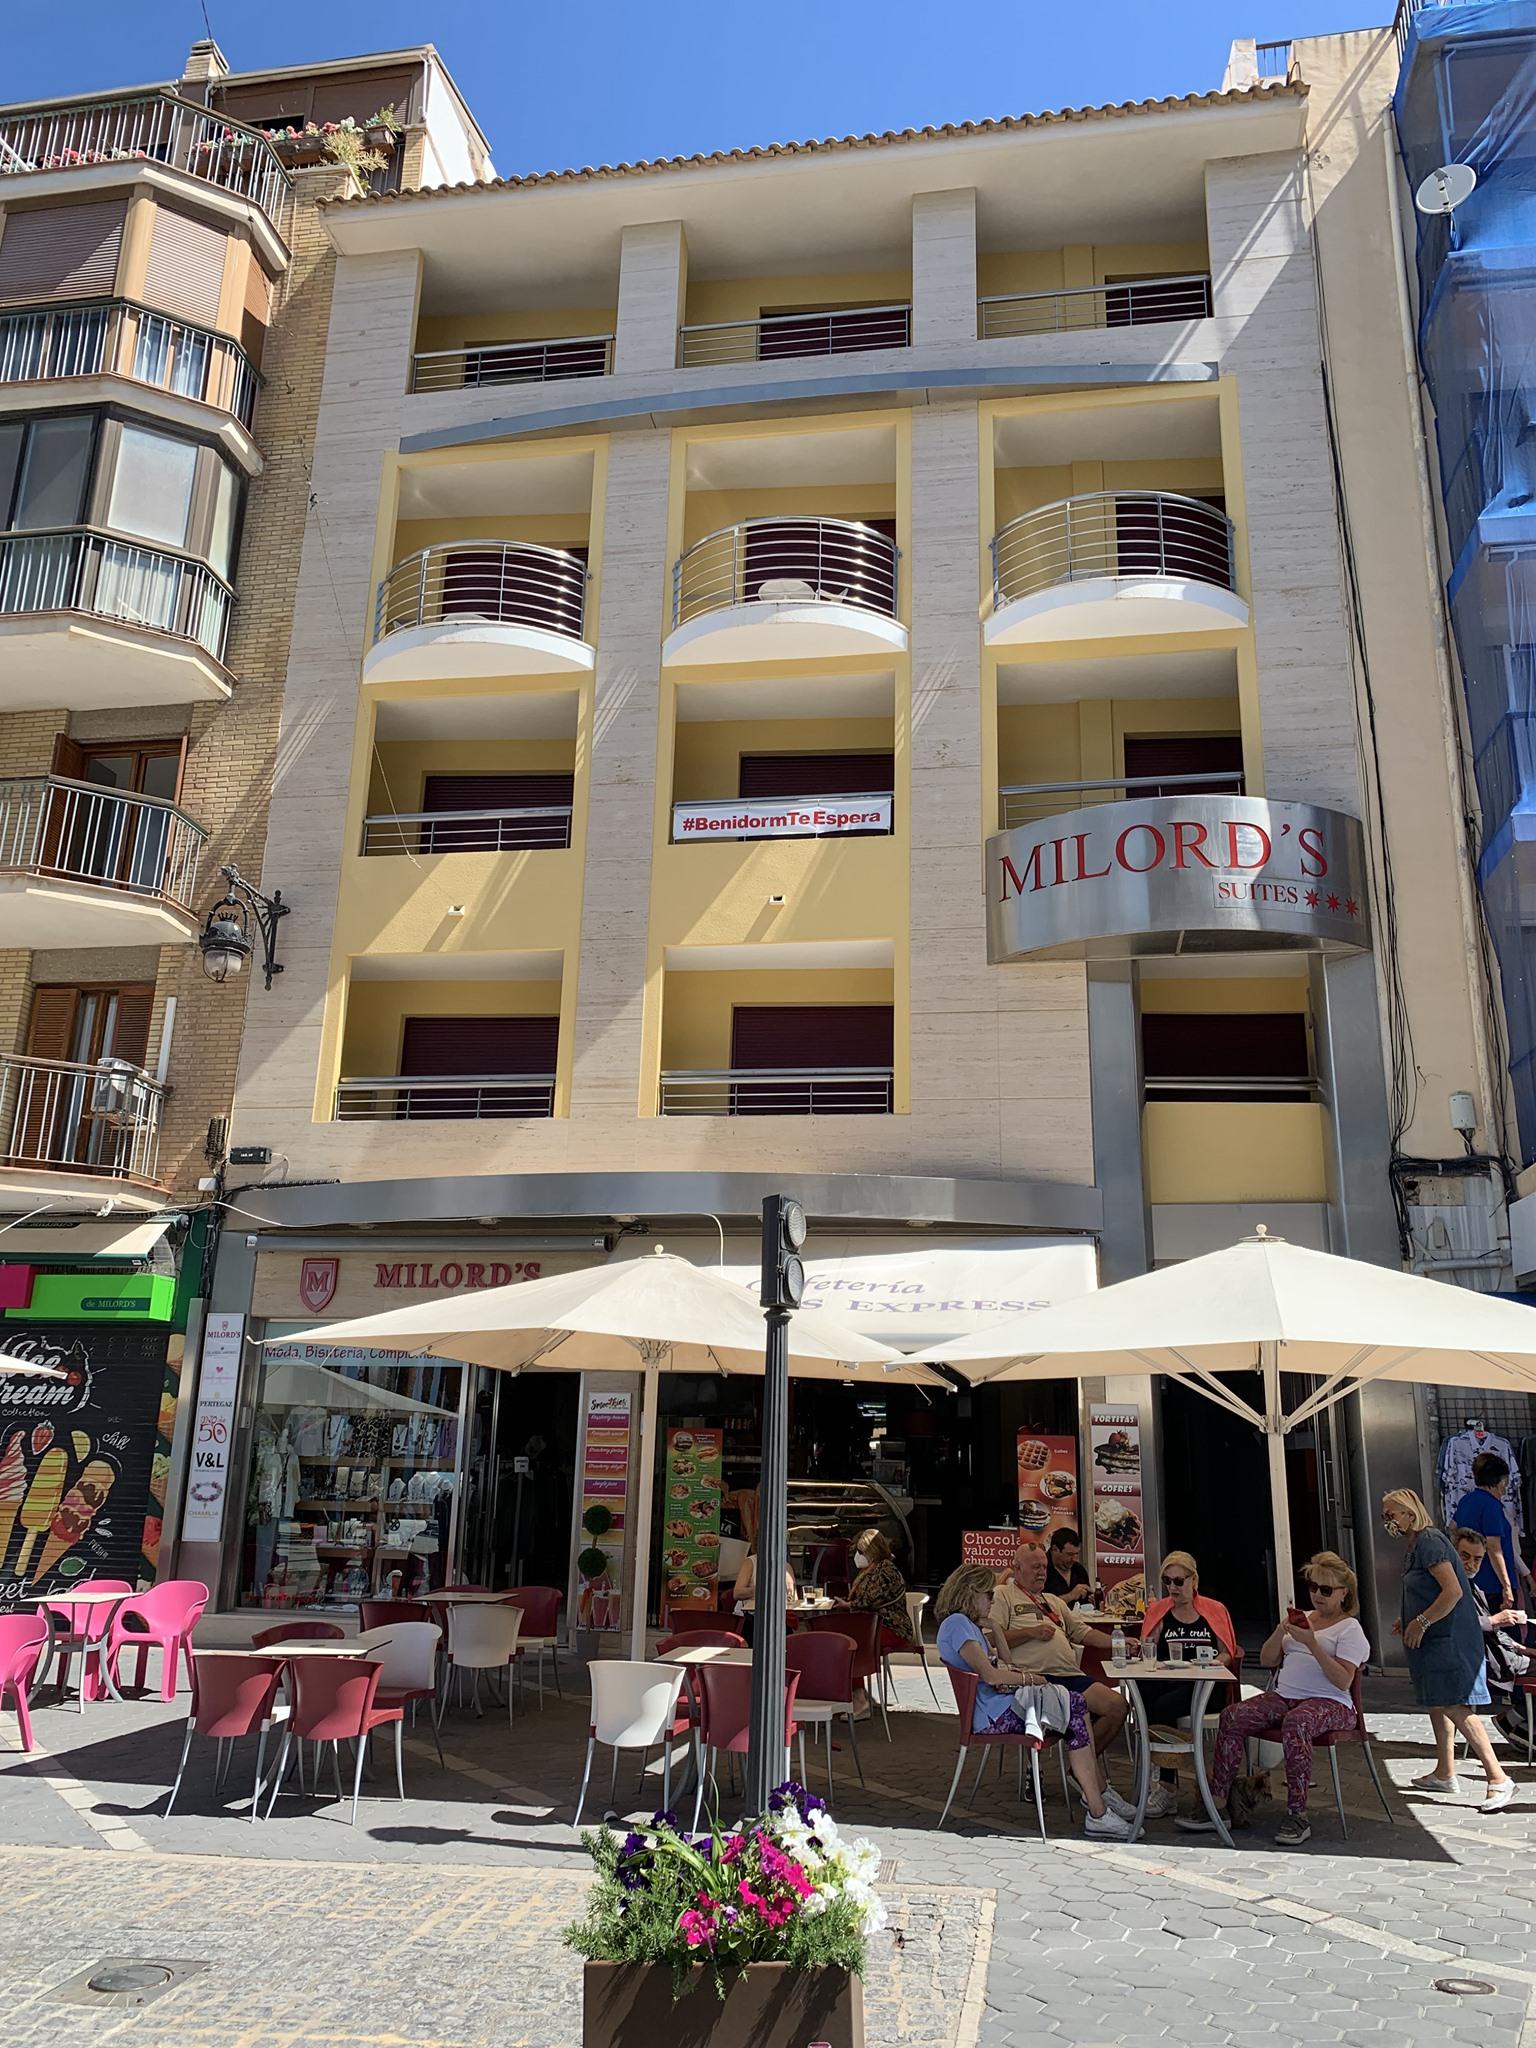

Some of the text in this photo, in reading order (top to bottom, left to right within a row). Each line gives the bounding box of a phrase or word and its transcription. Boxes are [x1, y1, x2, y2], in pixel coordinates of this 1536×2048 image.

[998, 821, 1329, 903] MILORD'S
[1217, 882, 1298, 904] SUITES
[308, 1271, 330, 1292] M
[374, 1263, 541, 1288] MILORD'S
[745, 1274, 925, 1294] Cfetería
[98, 1300, 136, 1308] MILORD'S
[849, 1299, 1052, 1312] EXPRESS
[264, 1345, 302, 1360] Moda,
[1094, 1415, 1135, 1423] TORTITAS
[199, 1422, 227, 1444] 50
[196, 1452, 224, 1468] V&L
[1101, 1484, 1133, 1493] GOFRES
[964, 1545, 996, 1556] valor
[964, 1555, 1009, 1567] churros
[1103, 1556, 1136, 1565] CREPES
[1165, 1628, 1211, 1639] don't create
